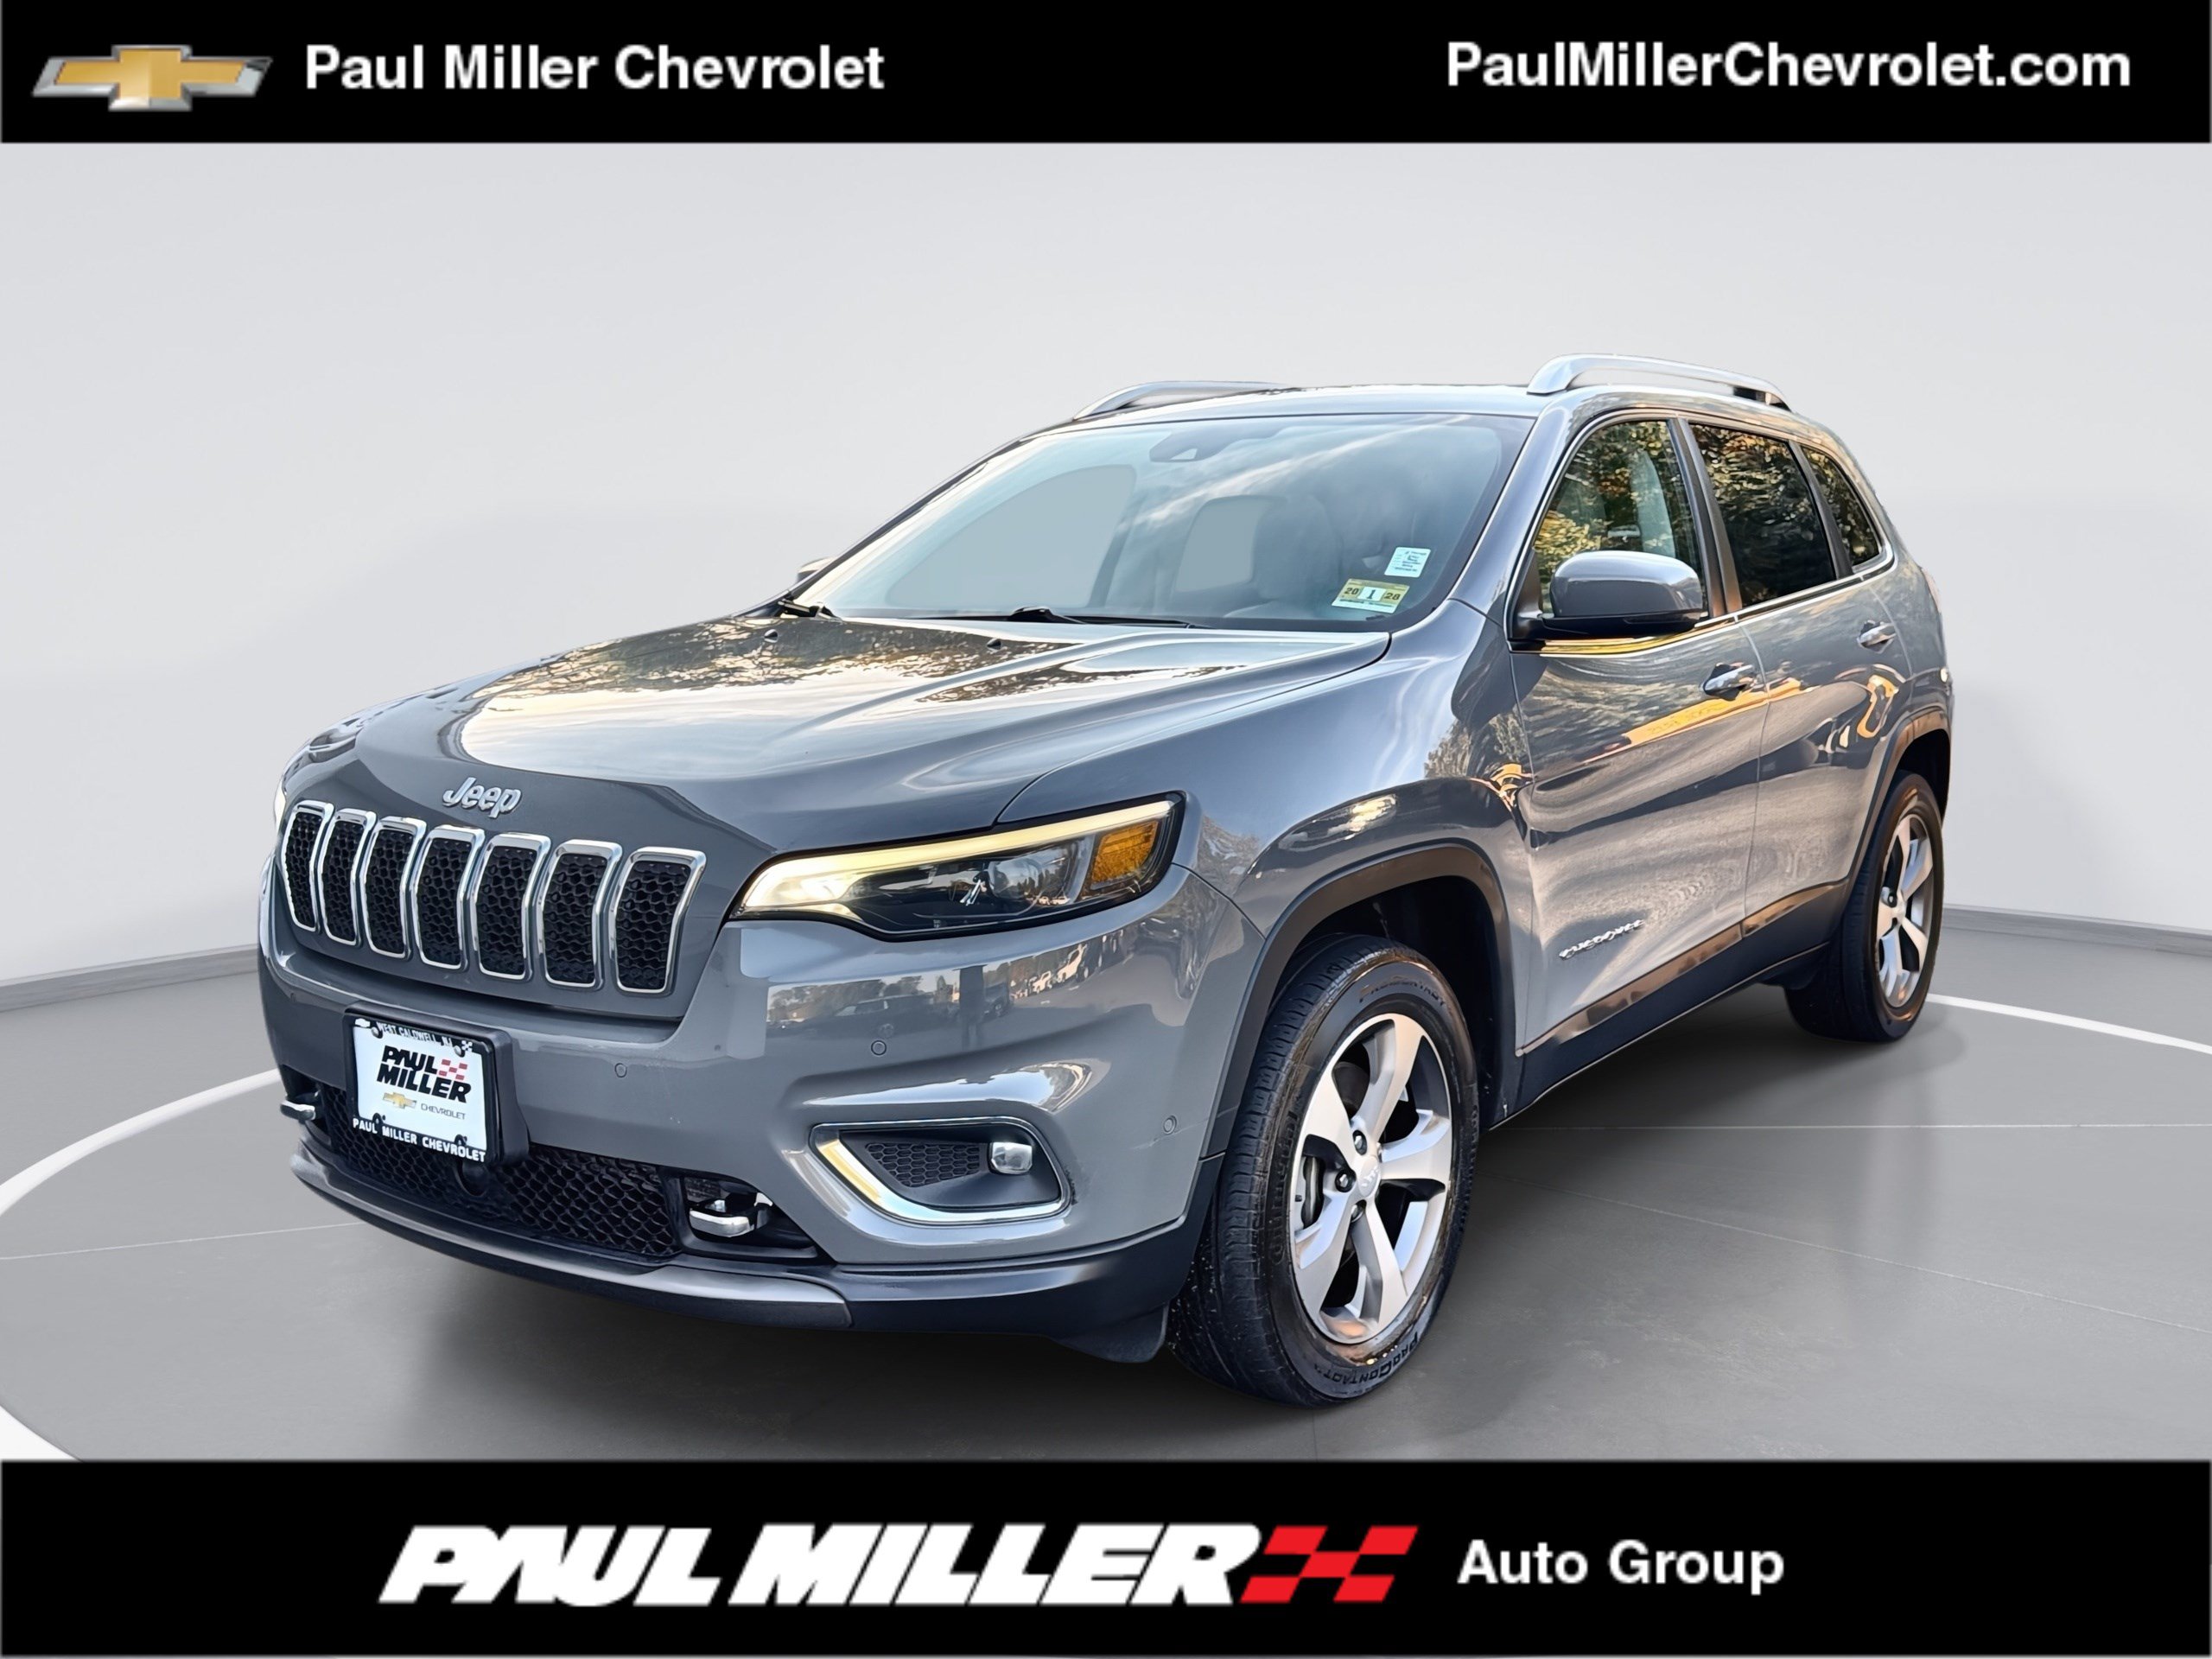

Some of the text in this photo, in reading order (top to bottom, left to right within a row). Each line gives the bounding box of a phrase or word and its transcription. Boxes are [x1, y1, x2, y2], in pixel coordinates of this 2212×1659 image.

[442, 777, 521, 818] Jeep
[377, 1021, 397, 1034] WEST
[382, 1045, 438, 1075] PAUL
[377, 1063, 472, 1103] MILLER
[420, 1103, 466, 1121] CHEVROLET
[353, 1117, 486, 1163] PAUL MILLER CHEVROLET
